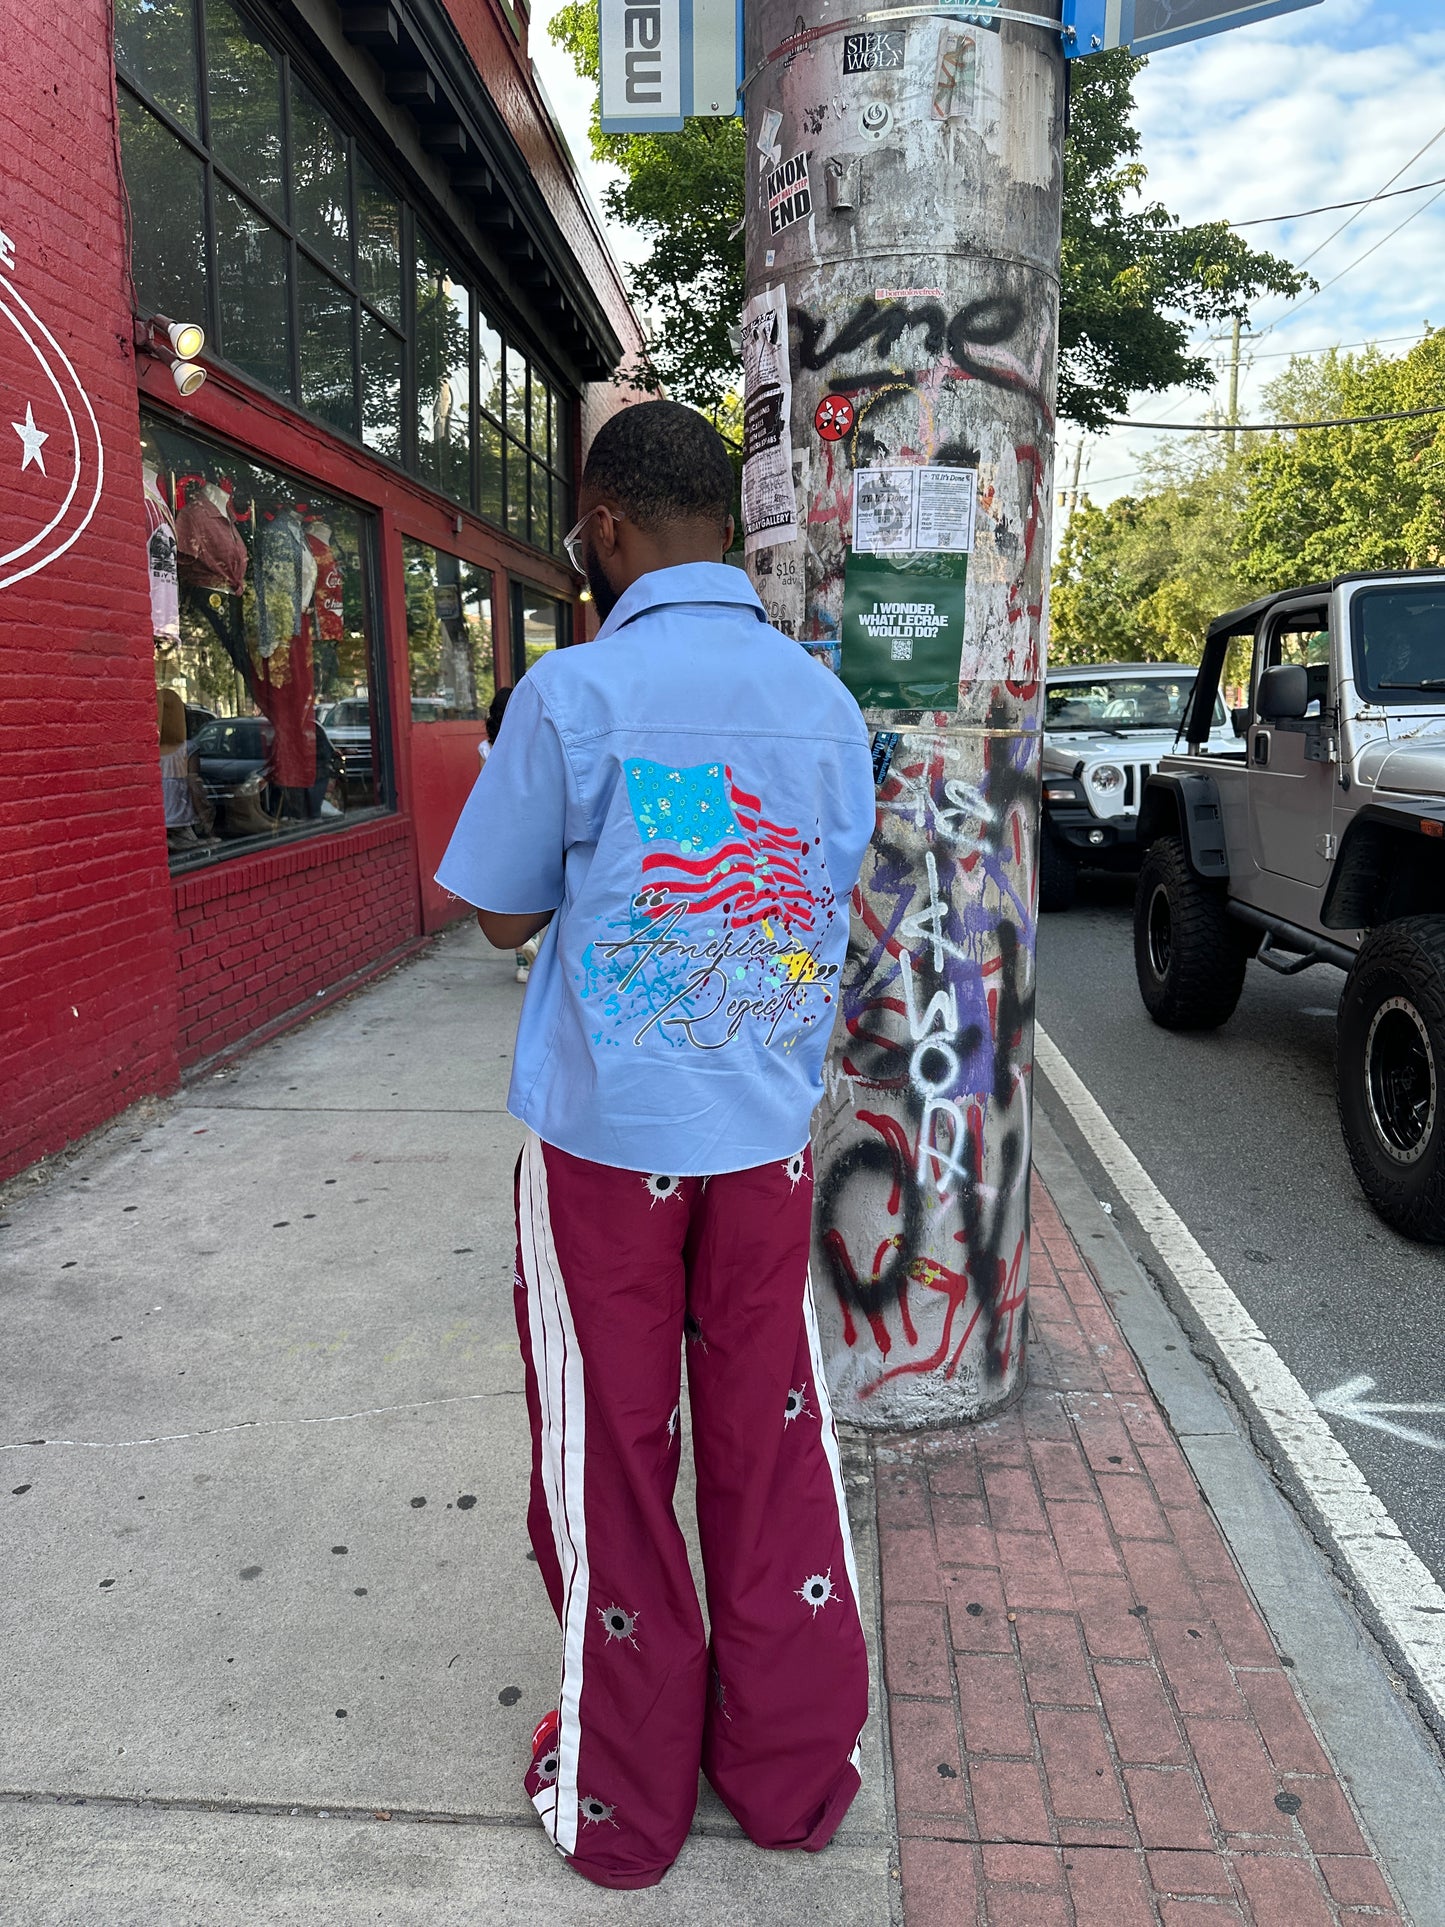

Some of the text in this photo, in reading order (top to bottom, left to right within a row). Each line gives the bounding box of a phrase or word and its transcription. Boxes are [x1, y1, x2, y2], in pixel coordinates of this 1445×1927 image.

[624, 0, 662, 104] ma
[847, 34, 891, 55] SILK
[767, 153, 807, 200] KNOX
[794, 178, 808, 192] STEP
[770, 189, 811, 234] END
[776, 560, 796, 579] $16
[782, 576, 797, 586] adv
[873, 603, 935, 615] I WONDER
[859, 615, 948, 627] WHAT LECRAE
[868, 626, 938, 638] WOULD DO?
